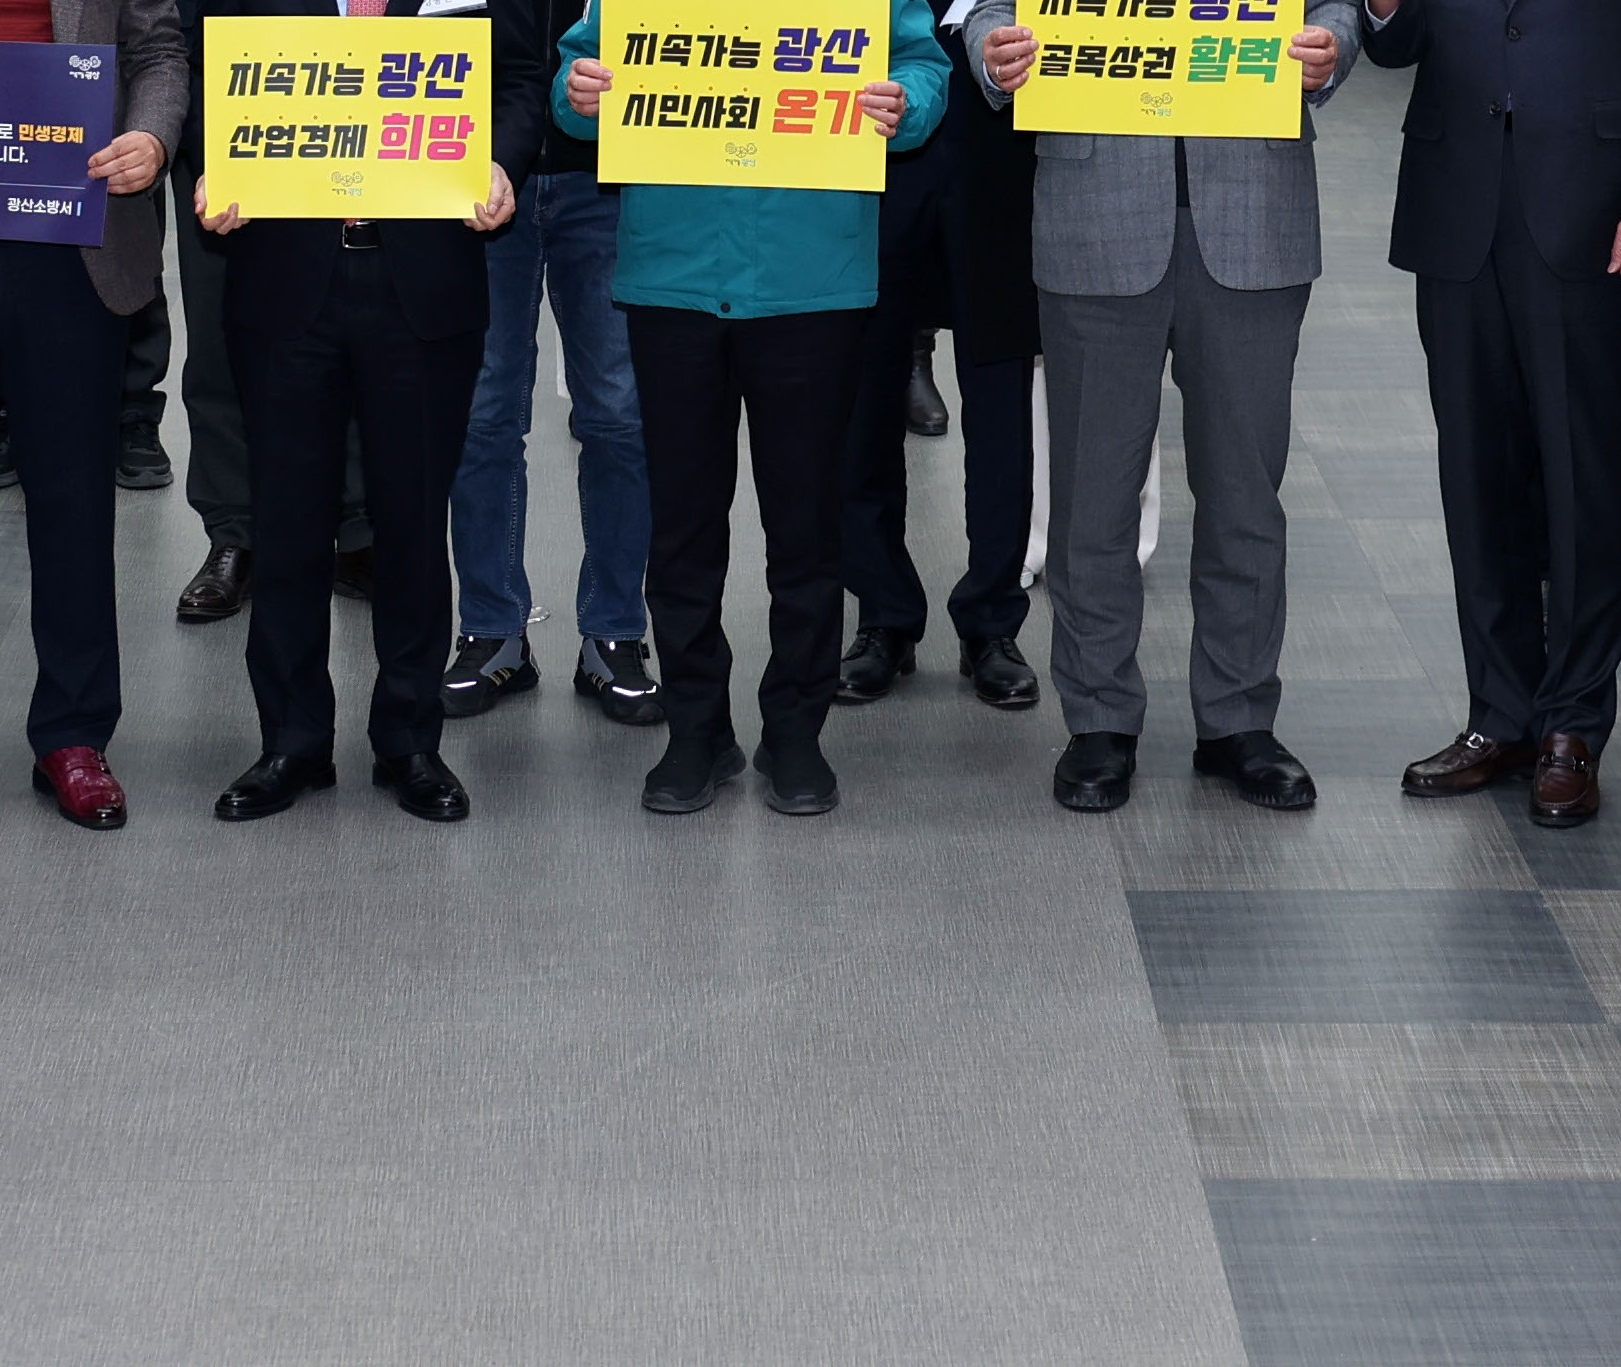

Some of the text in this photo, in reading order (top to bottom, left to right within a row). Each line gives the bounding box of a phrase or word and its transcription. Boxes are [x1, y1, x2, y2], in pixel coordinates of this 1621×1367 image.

[622, 27, 872, 75] 지속가능 광산
[1038, 36, 1282, 84] 골목상권 활력
[226, 51, 474, 100] 지속가능 광산
[18, 124, 84, 144] 민생경제
[621, 87, 865, 135] 시민사회 온기
[227, 111, 476, 161] 산업경제 희망
[7, 197, 73, 216] 광산소방서
